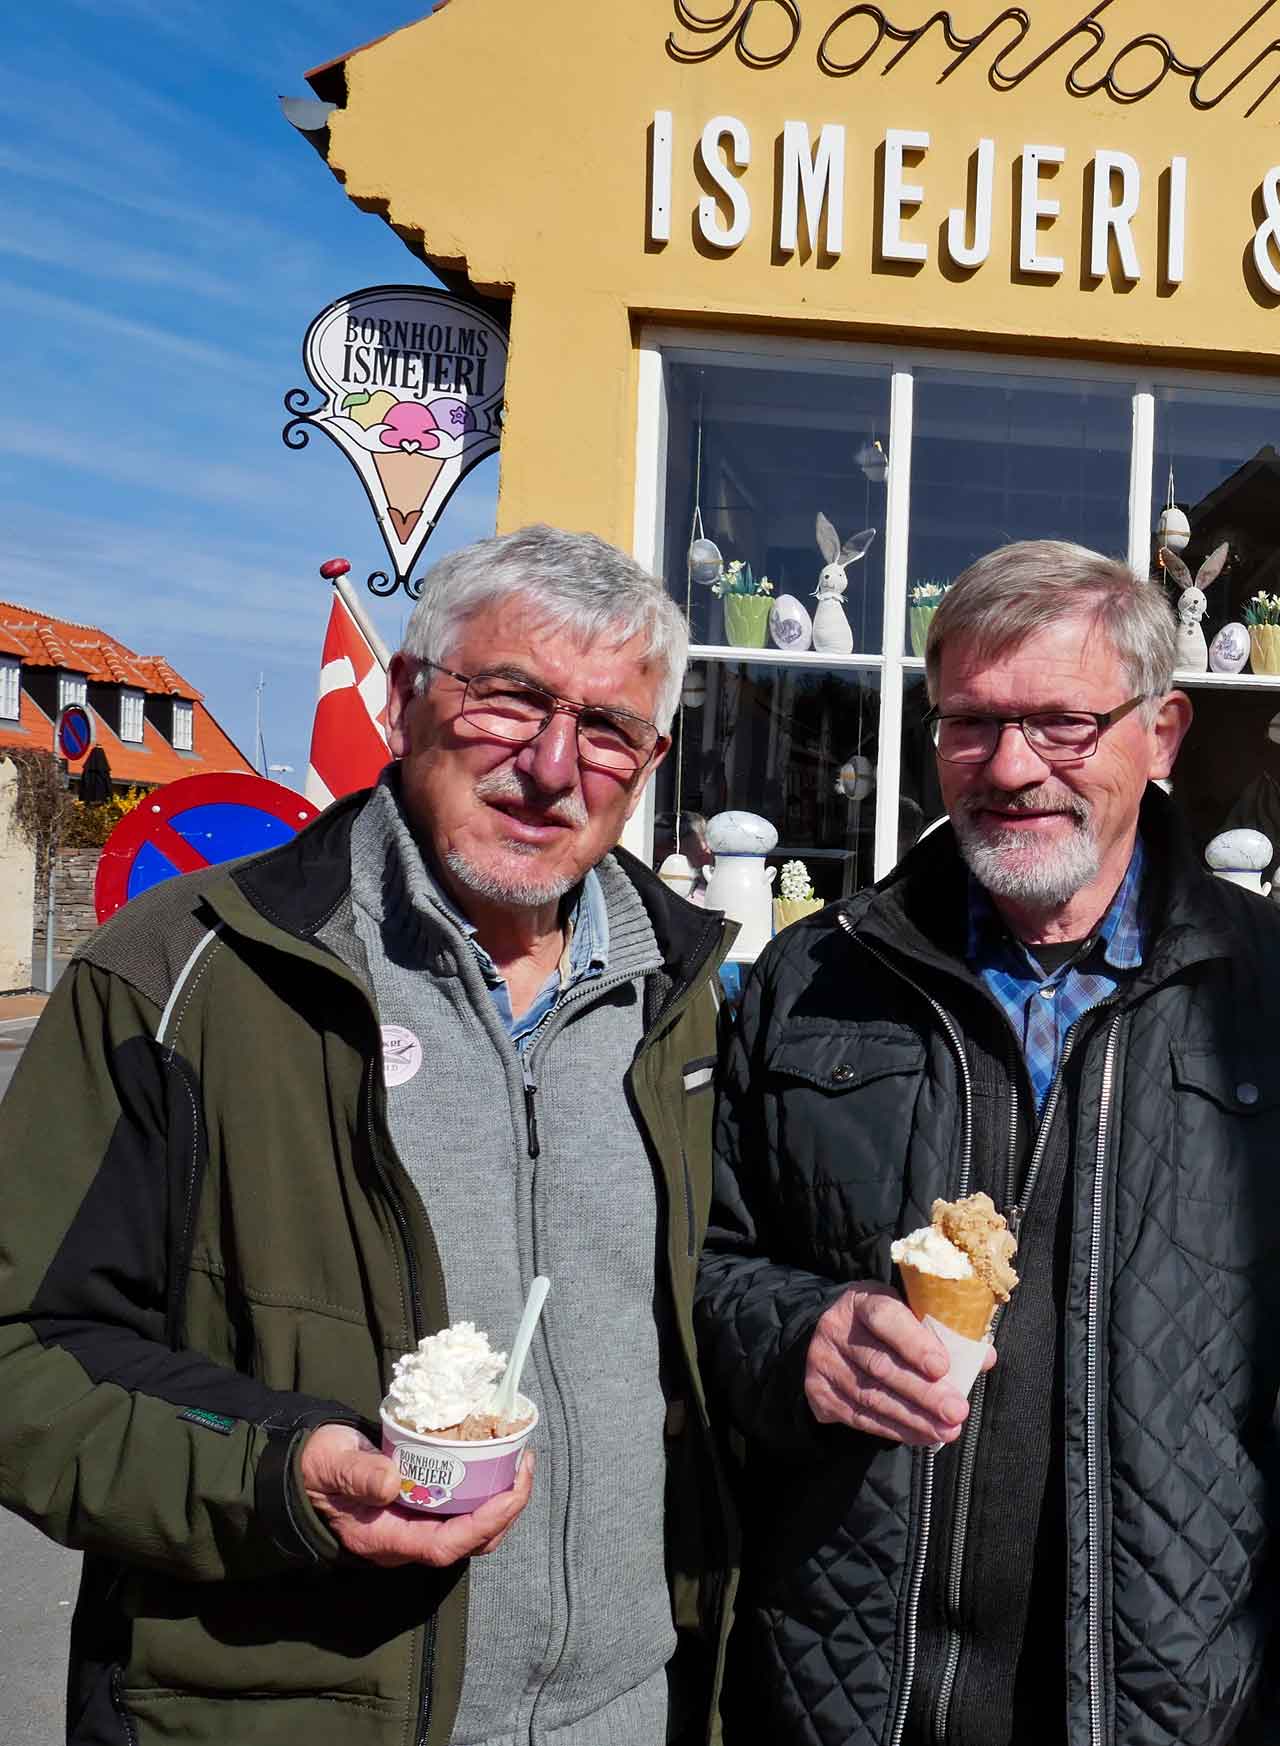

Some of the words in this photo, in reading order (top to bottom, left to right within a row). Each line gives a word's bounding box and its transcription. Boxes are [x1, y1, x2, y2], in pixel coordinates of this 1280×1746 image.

[650, 110, 1187, 285] ISMEJERI
[344, 315, 489, 358] BORNHOLMS
[341, 344, 488, 400] ISMEJERI
[400, 1449, 455, 1472] BORNHOLMS
